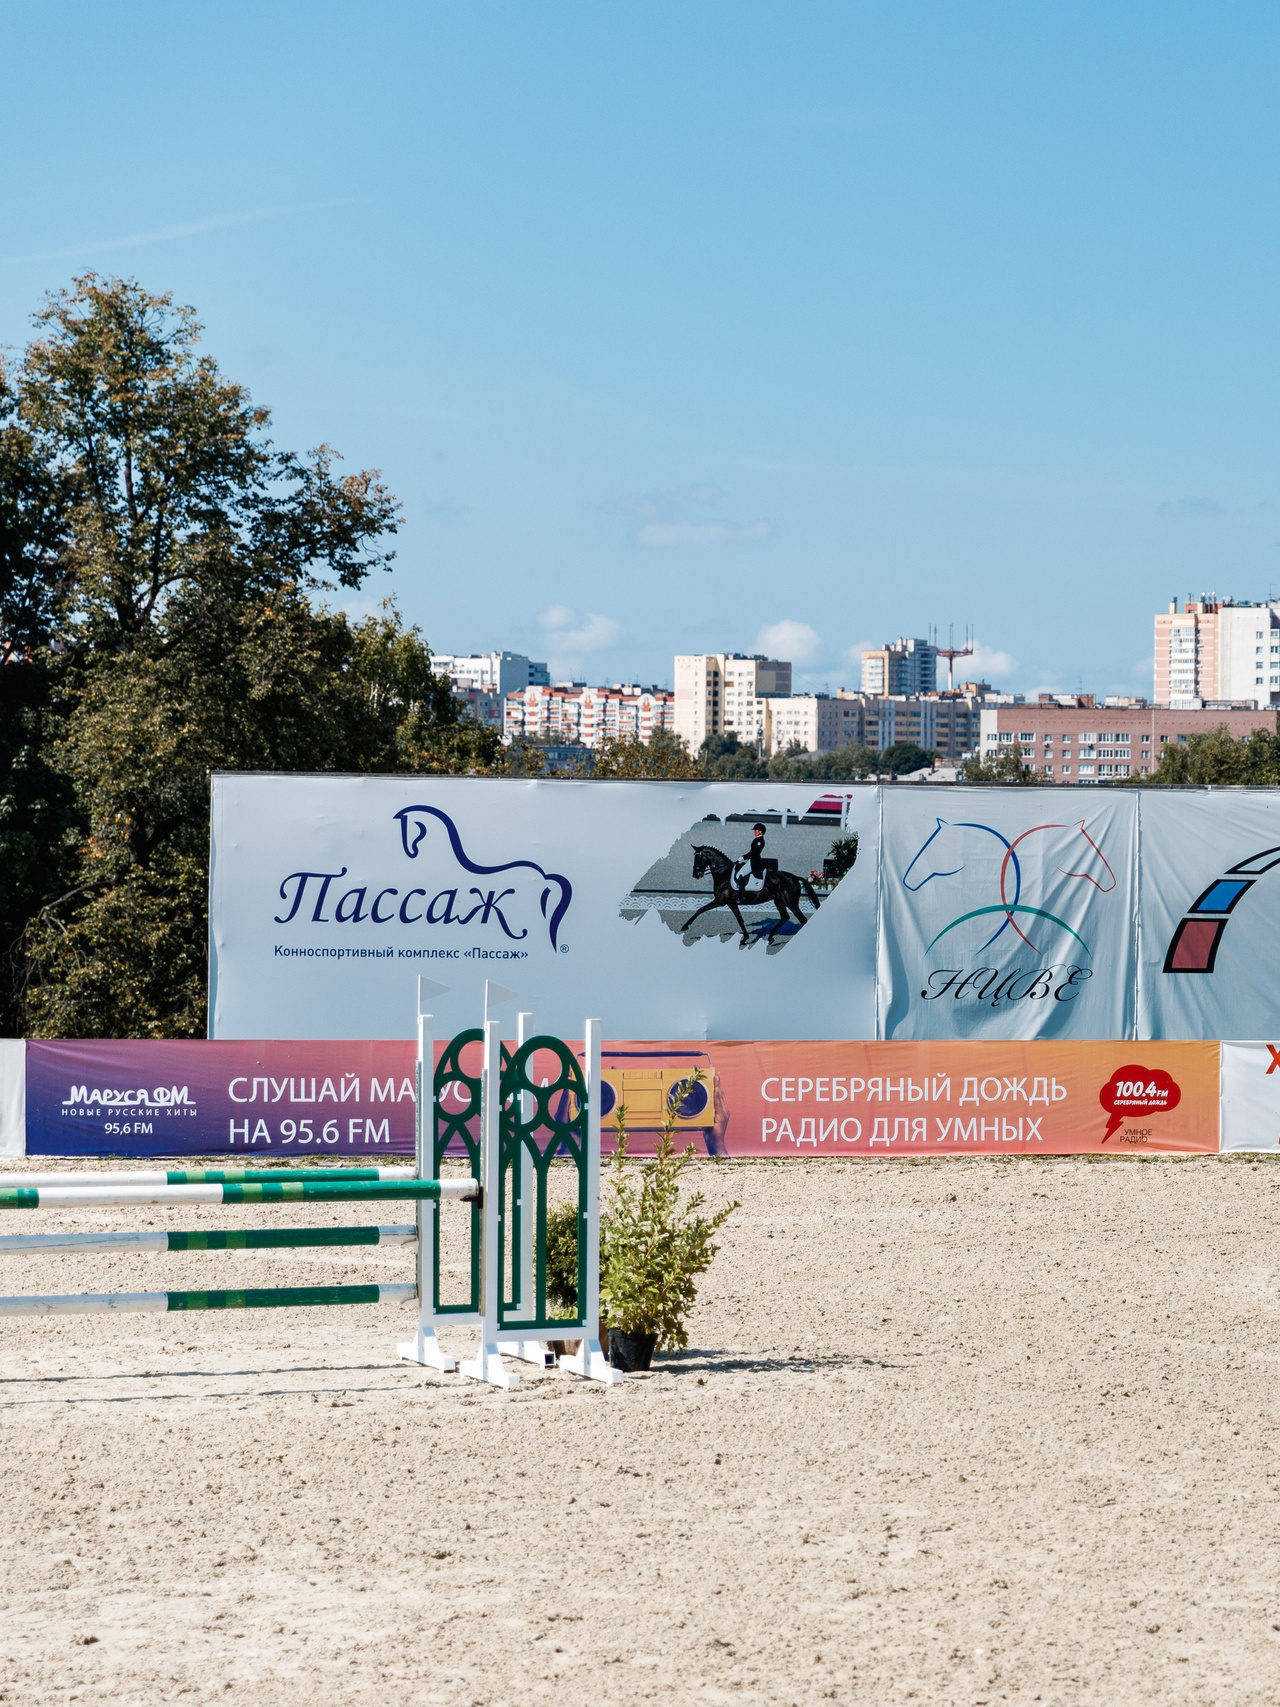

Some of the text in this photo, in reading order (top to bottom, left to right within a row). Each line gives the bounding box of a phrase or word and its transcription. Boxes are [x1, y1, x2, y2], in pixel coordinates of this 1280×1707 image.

[273, 866, 528, 940] Пассаж
[274, 944, 529, 960] Конноспортивный комплекс «Пассаж»
[228, 1073, 360, 1103] СЛУШАЙ
[761, 1071, 1068, 1107] СЕРЕБРЯНЫЙ ДОЖДЬ
[1116, 1081, 1157, 1097] 100.4
[61, 1108, 198, 1117] НОВЫЕ РУССКИЕ ХИТЫ
[104, 1122, 153, 1136] 95,6 FM
[229, 1118, 391, 1144] НА 95.6 FM
[761, 1117, 1044, 1147] РАДИО ДЛЯ УМНЫХ
[1120, 1136, 1148, 1144] РАДИО
